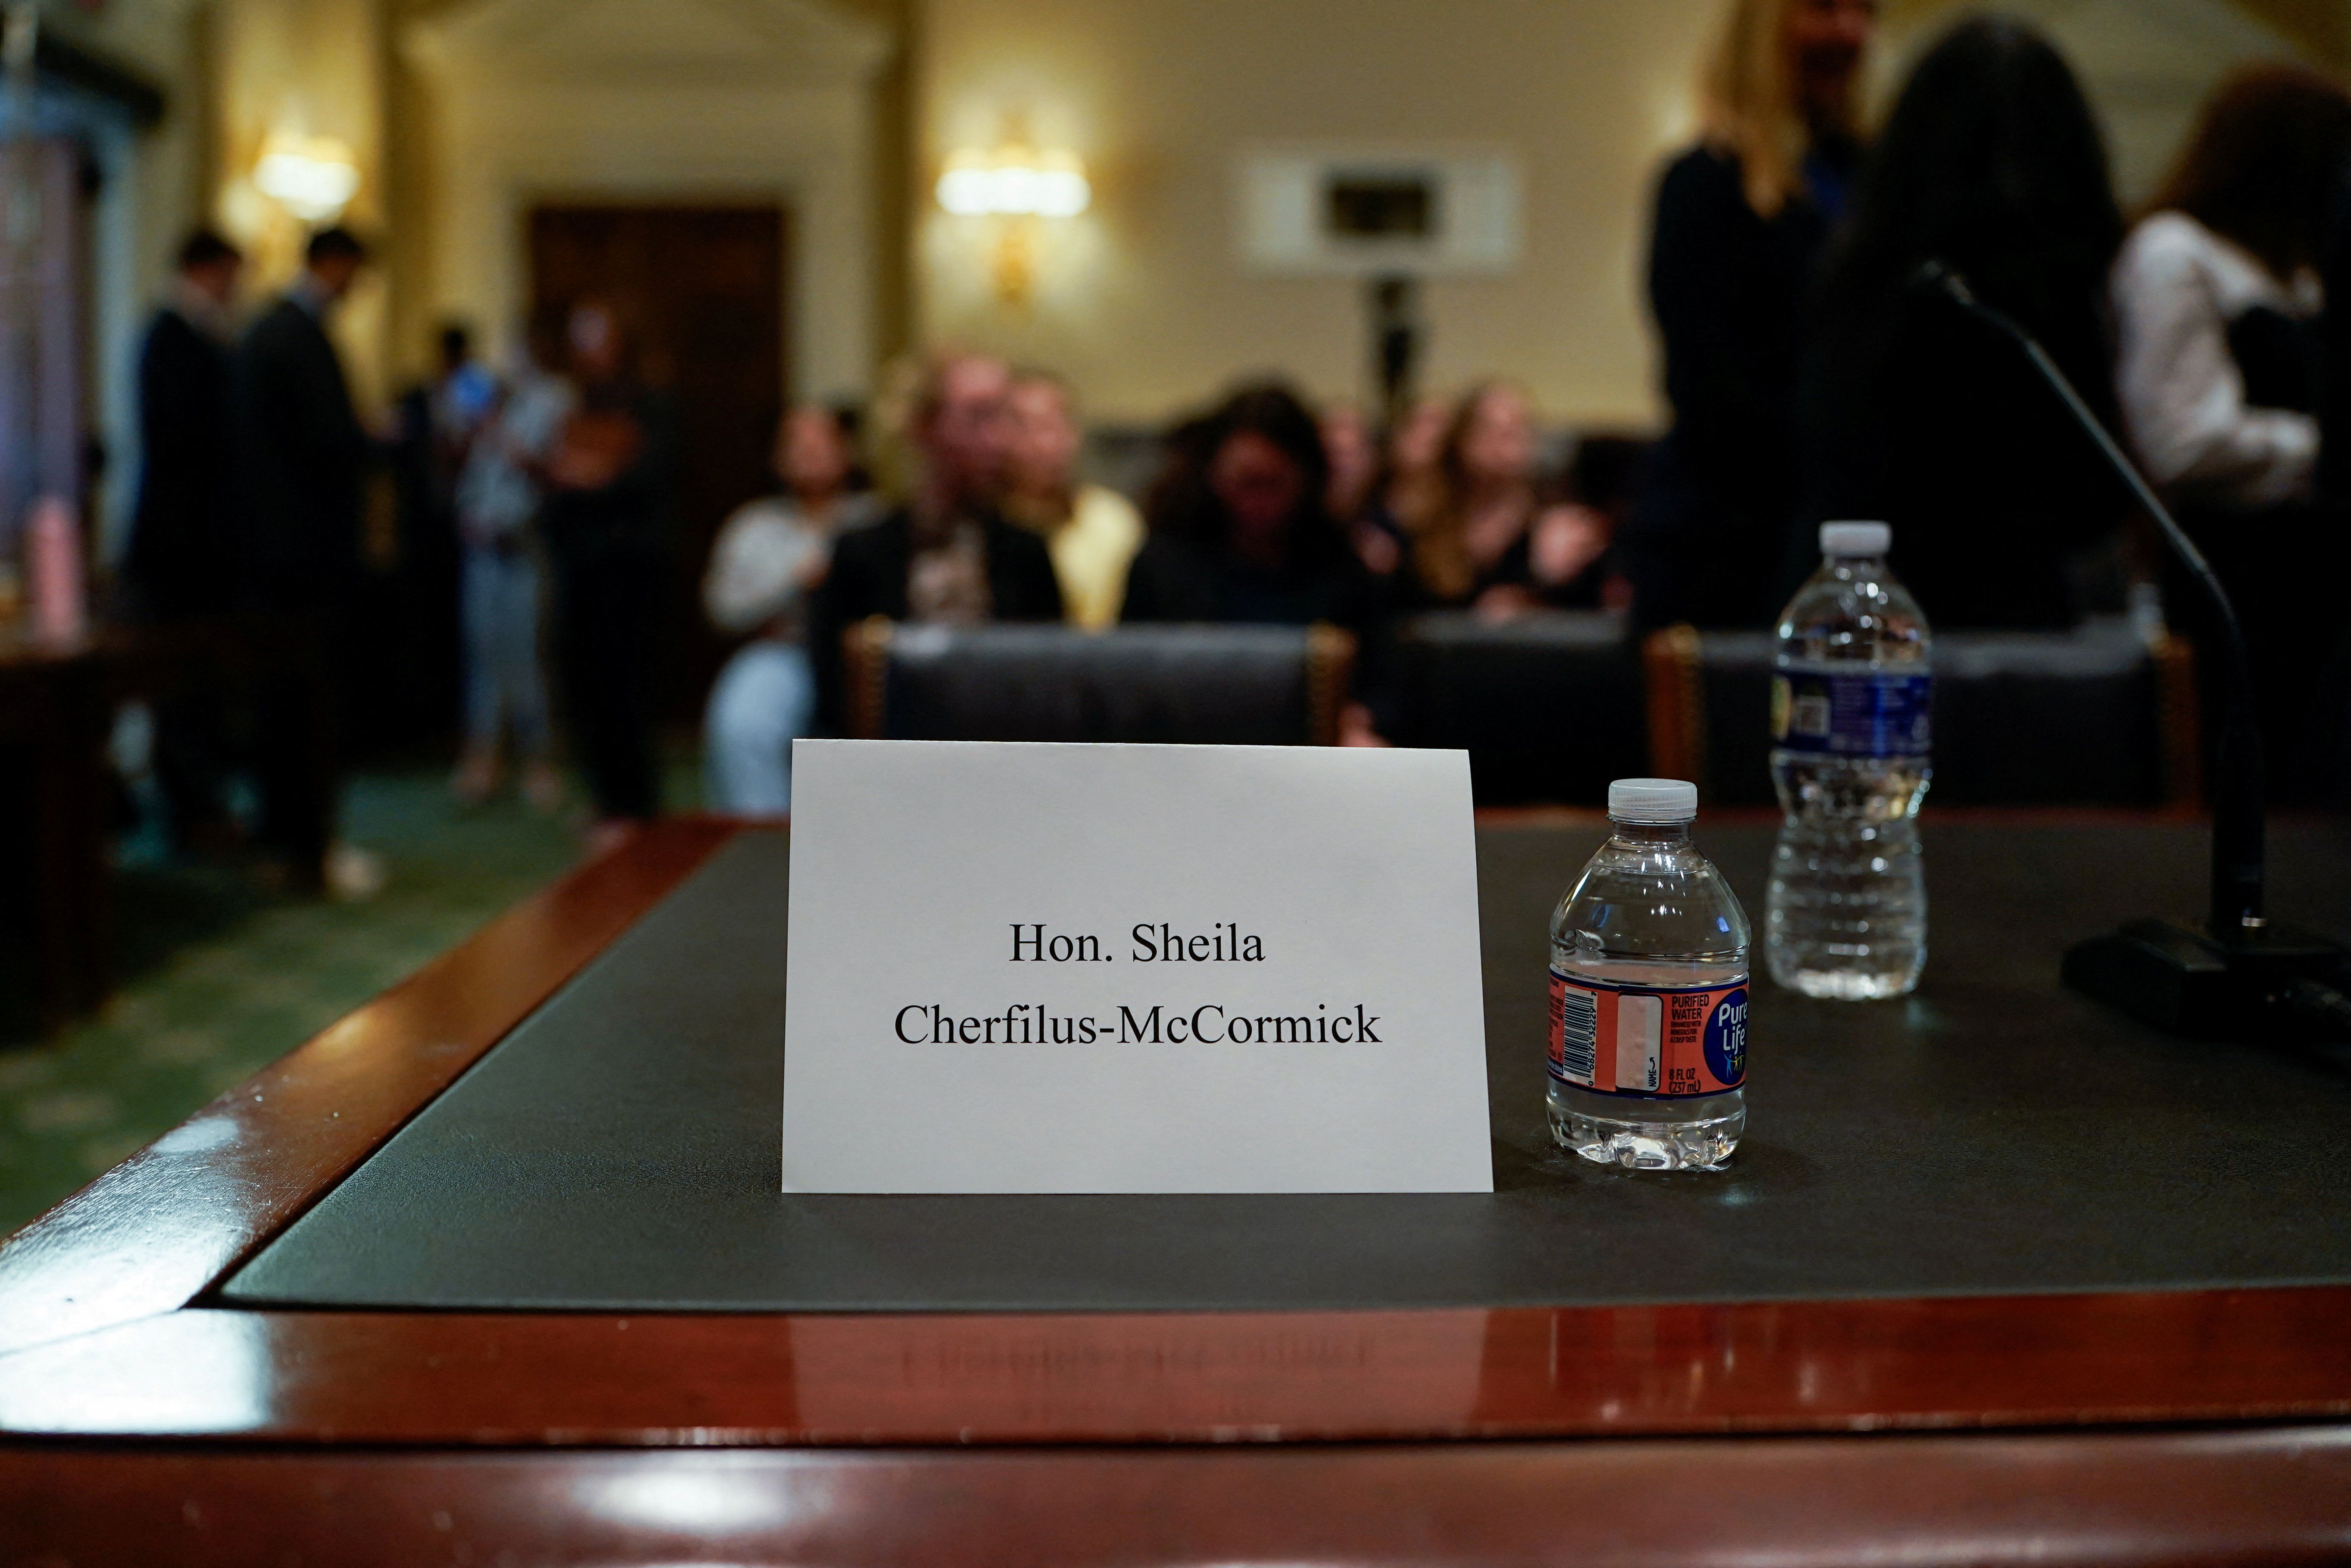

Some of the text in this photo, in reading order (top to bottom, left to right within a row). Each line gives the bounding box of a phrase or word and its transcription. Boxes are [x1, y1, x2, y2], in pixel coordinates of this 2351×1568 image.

[1009, 923, 1266, 962] Hon. Sheila
[1671, 994, 1709, 1008] PURIFIED
[895, 1004, 1383, 1044] Cherfilus-McCormick
[1588, 1007, 1596, 1037] 32229
[1671, 1008, 1702, 1020] WATER
[1718, 1002, 1747, 1027] Pure
[1724, 1024, 1745, 1055] Life
[1648, 1069, 1657, 1087] NAME
[1669, 1068, 1696, 1080] 8 FL OZ
[1669, 1079, 1701, 1094] (237 mL)
